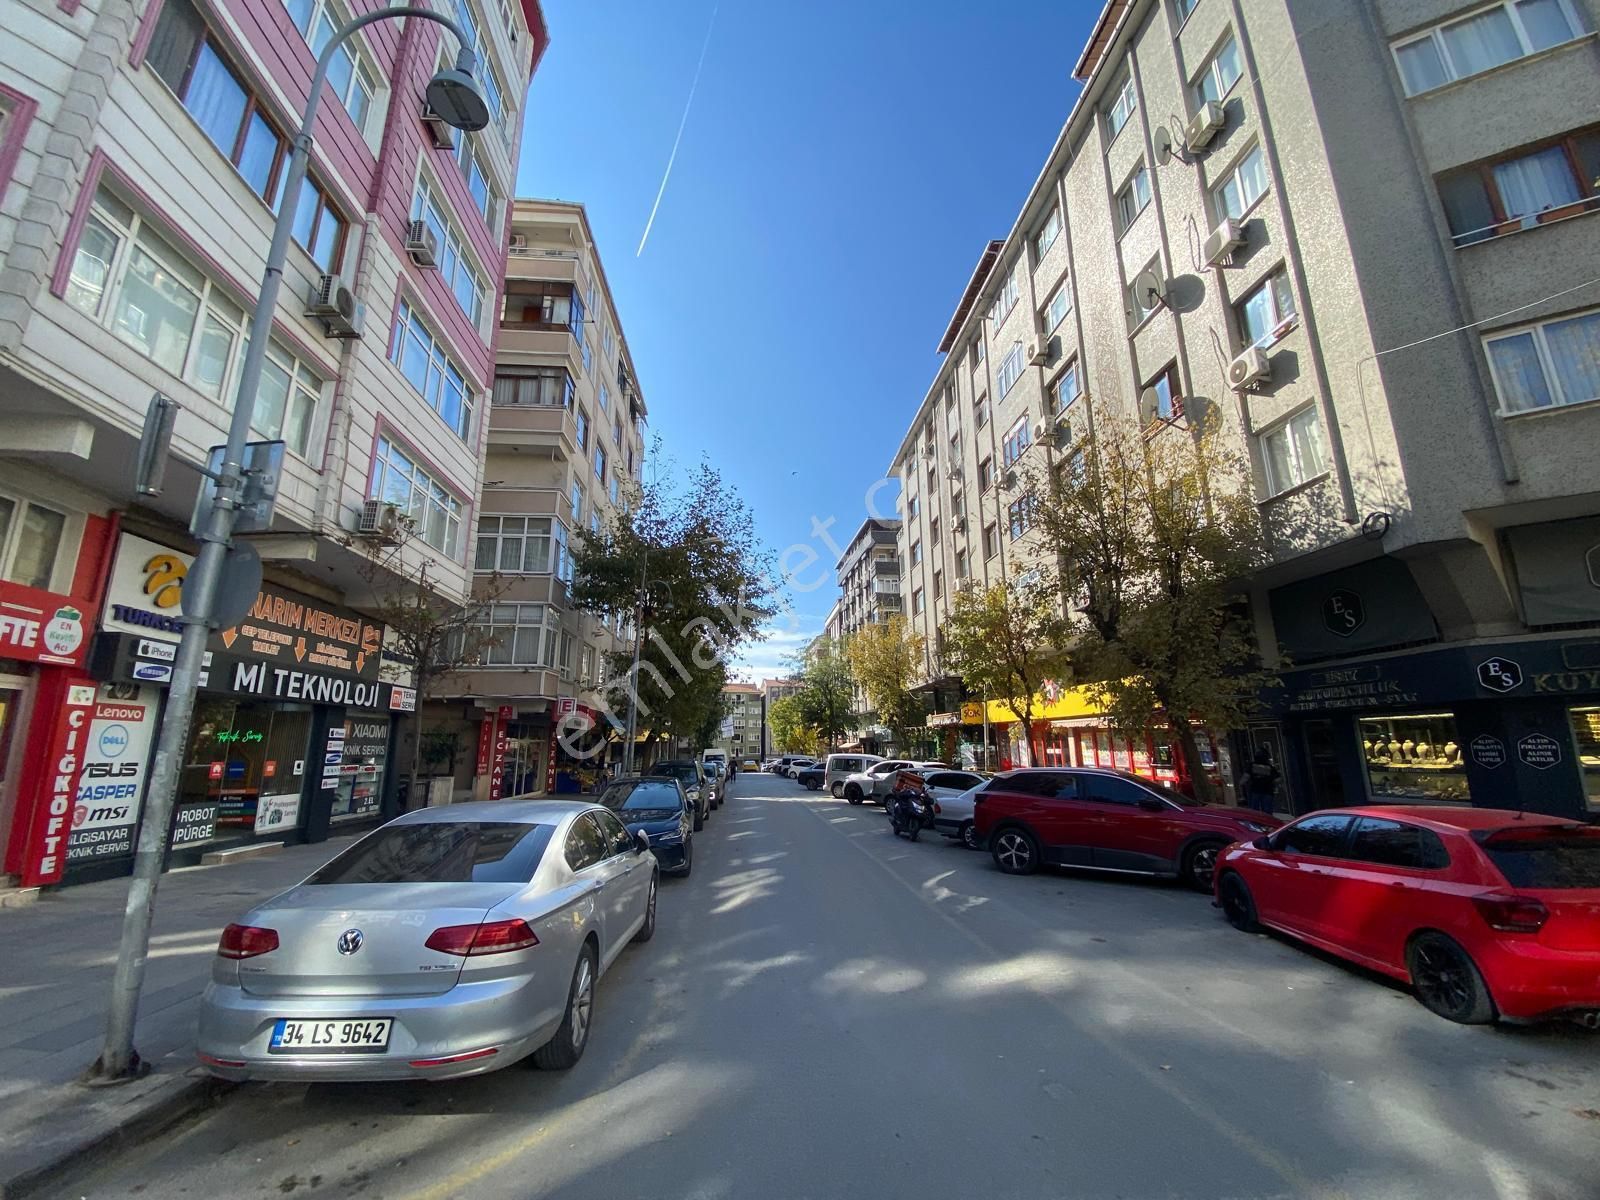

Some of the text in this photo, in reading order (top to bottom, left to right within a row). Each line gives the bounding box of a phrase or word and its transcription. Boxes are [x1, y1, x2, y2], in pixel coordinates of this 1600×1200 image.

[60, 622, 72, 631] EN
[247, 592, 362, 645] NARIM MERKEZİ
[151, 646, 173, 659] iPhone
[233, 661, 379, 708] Mİ TEKNOLOJİ
[96, 705, 142, 719] Lenovo
[562, 701, 572, 711] E
[352, 723, 388, 738] XIAOMI
[103, 736, 125, 745] DELL
[343, 744, 361, 755] KNİK
[80, 762, 139, 779] ASUS
[492, 730, 505, 797] ECZANE
[75, 784, 137, 801] CASPER
[88, 805, 130, 822] msi
[182, 807, 215, 823] ROBOT
[173, 825, 213, 843] PÜRGE
[282, 1022, 386, 1044] 34 LS 9642
